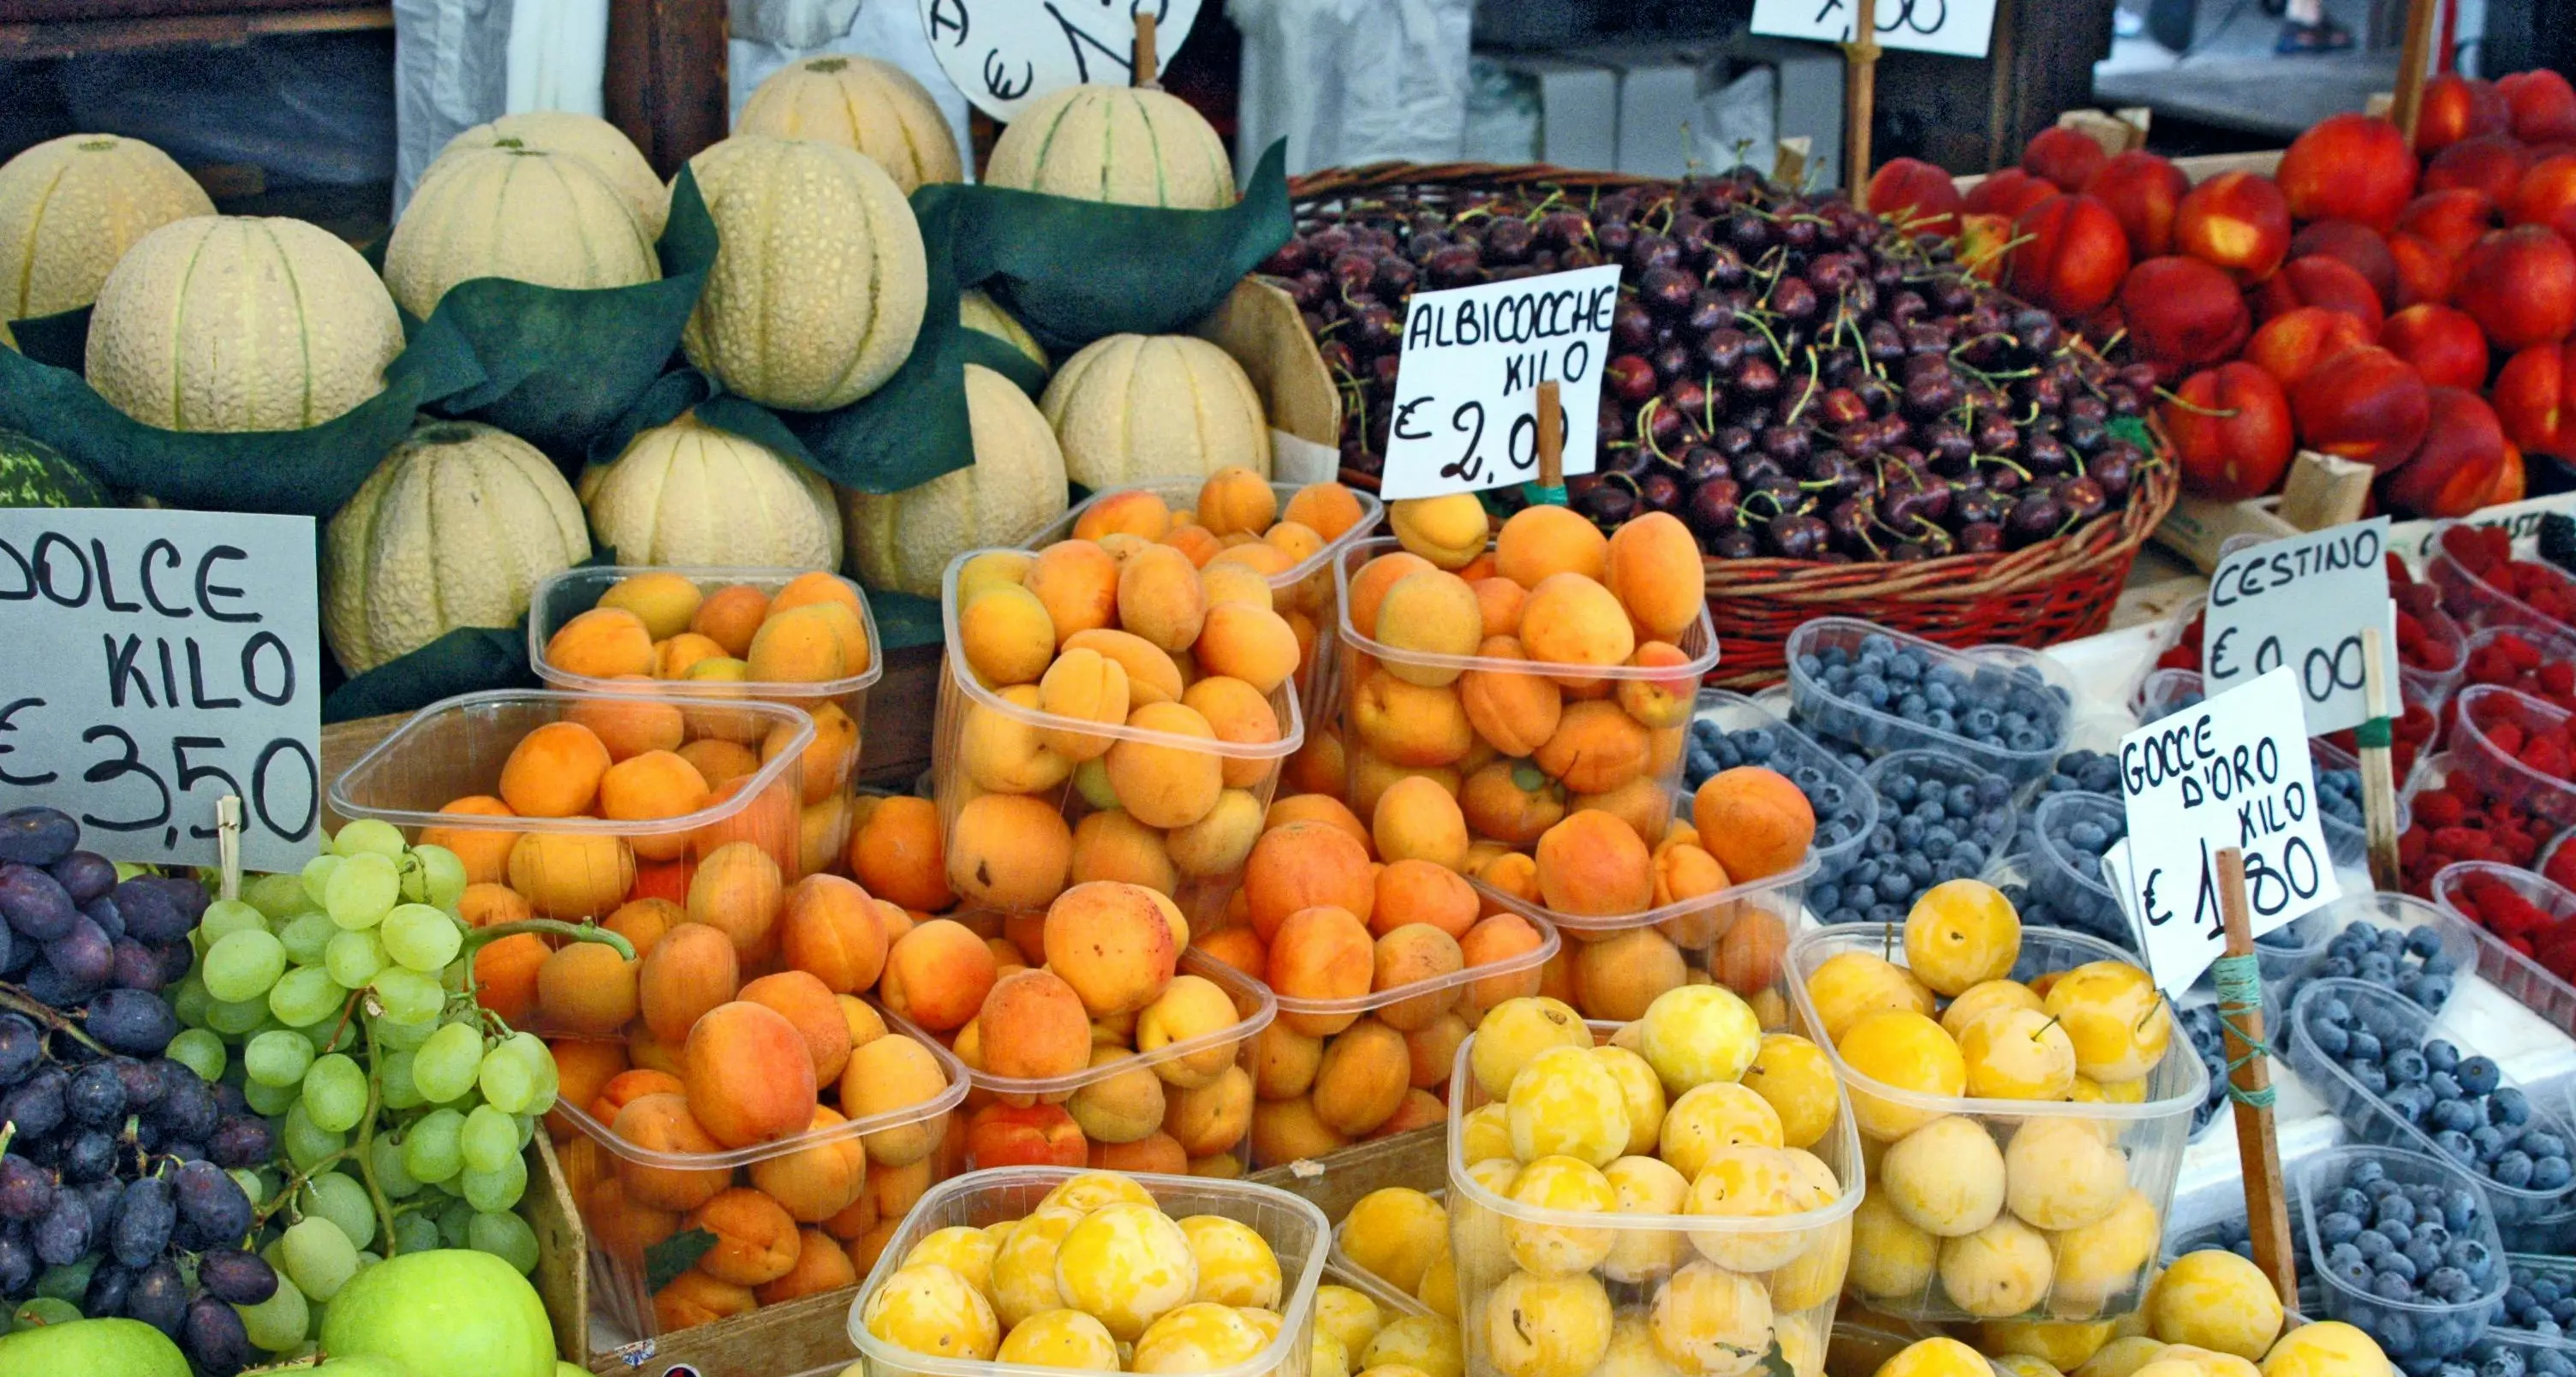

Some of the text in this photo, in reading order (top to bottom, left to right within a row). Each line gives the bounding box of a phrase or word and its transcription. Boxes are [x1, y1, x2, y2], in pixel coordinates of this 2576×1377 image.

[1409, 285, 1615, 350] ALBICOCCHE
[1503, 341, 1589, 396] KILO
[1394, 396, 1435, 439] €
[2212, 528, 2379, 607] CESTINO
[104, 631, 295, 709] KILO
[2210, 627, 2239, 679] €
[81, 724, 319, 850] 3,50
[2122, 714, 2215, 795] GOCCE
[2181, 736, 2278, 808] D'ORO
[2238, 782, 2305, 848] KILO
[2143, 868, 2173, 926] €
